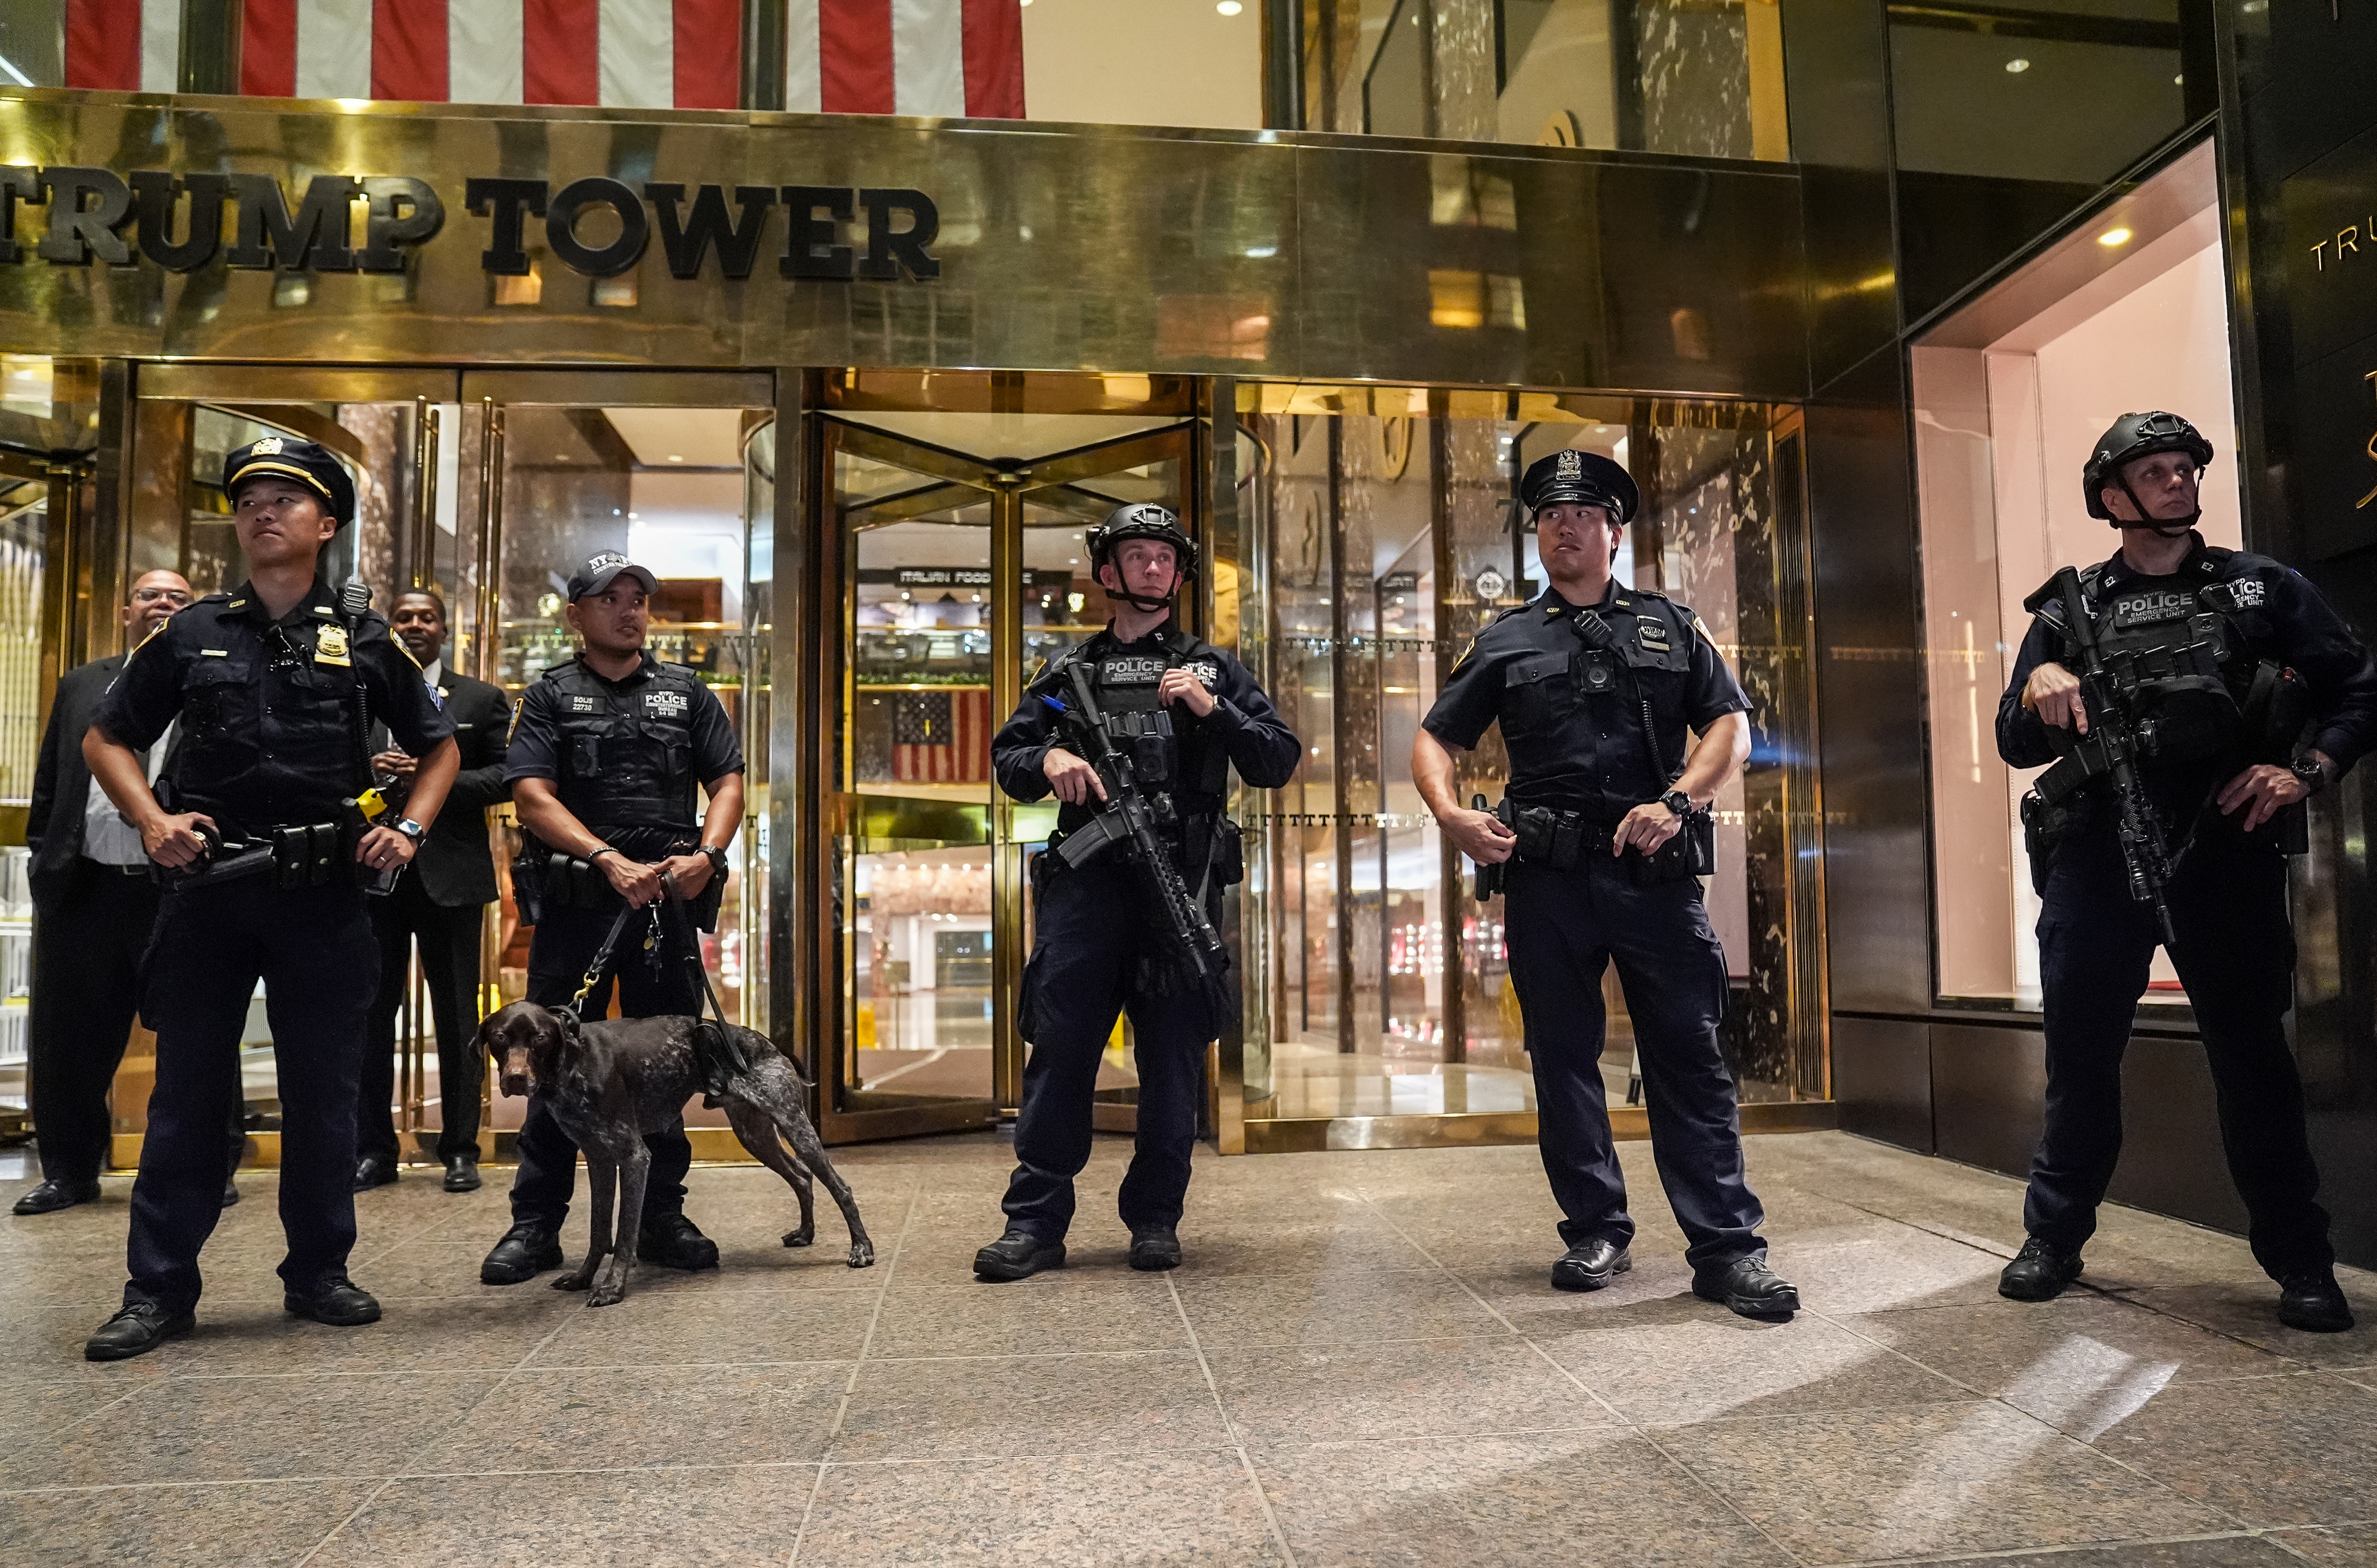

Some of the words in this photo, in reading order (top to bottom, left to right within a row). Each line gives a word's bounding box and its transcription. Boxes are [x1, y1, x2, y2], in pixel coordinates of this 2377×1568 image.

[465, 176, 940, 281] TOWER
[588, 554, 607, 569] NY
[2201, 561, 2214, 572] E2
[2104, 576, 2116, 588] E2
[2226, 578, 2246, 588] NYPD
[2143, 591, 2166, 599] NYPD
[2229, 581, 2265, 599] LICE
[2119, 593, 2193, 615] POLICE
[2236, 594, 2259, 604] GENCY
[2127, 614, 2161, 624] SERVICE
[2166, 610, 2186, 618] UNIT
[2130, 606, 2180, 619] EMERGENCY
[1105, 661, 1164, 673] POLICE
[1181, 665, 1218, 680] LICE
[645, 695, 688, 705] POLICE
